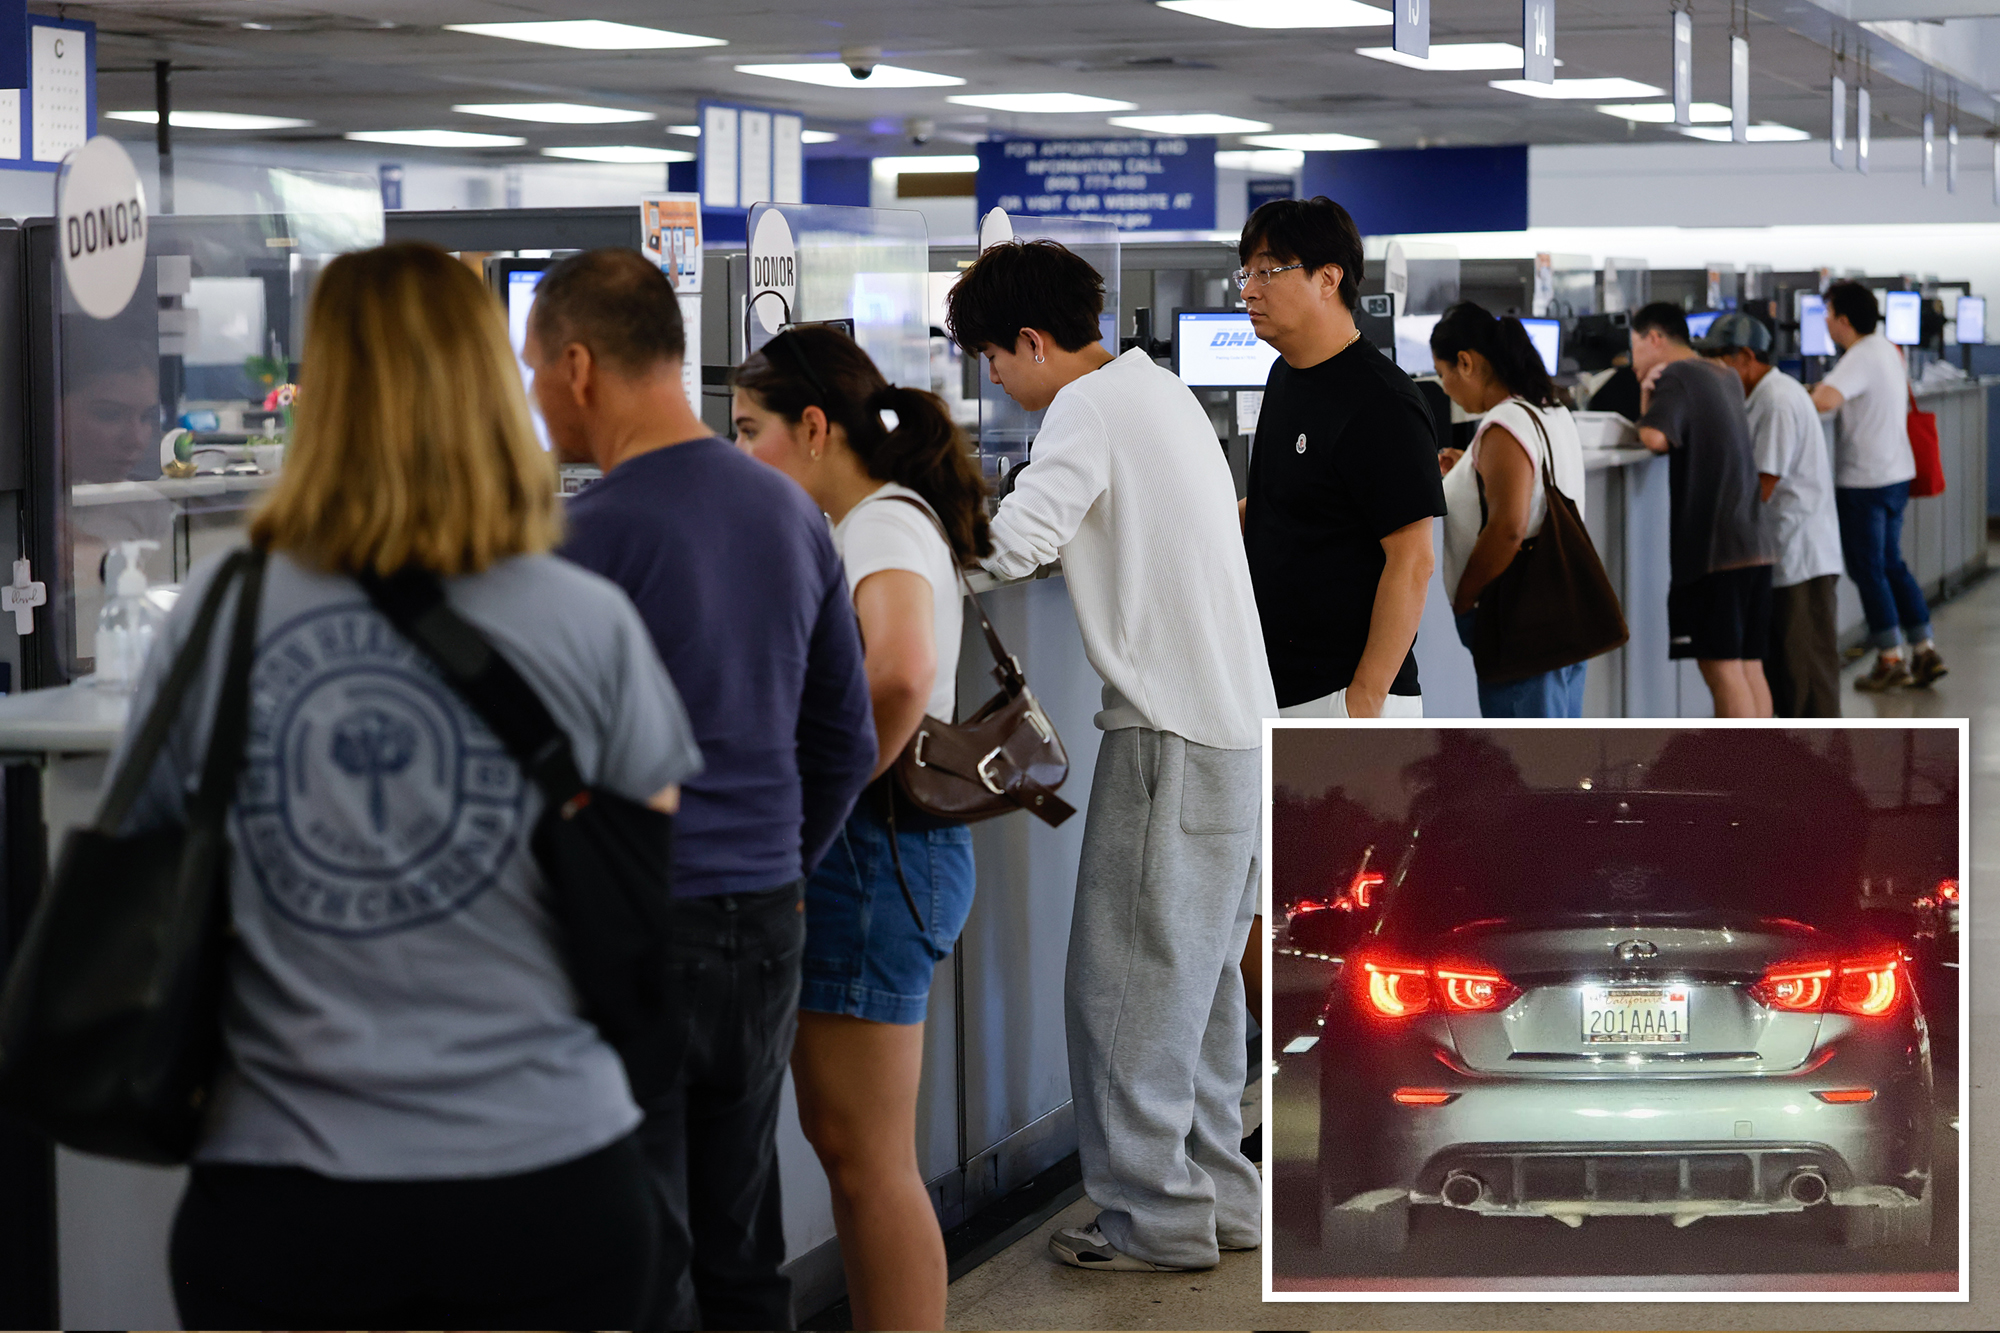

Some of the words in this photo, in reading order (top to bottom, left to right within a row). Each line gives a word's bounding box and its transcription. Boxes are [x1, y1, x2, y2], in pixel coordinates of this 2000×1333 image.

[1533, 3, 1547, 57] 14
[54, 38, 65, 59] C
[1154, 139, 1188, 155] AND
[1026, 159, 1122, 175] INFORMATION
[1125, 158, 1164, 174] CALL
[1103, 194, 1169, 210] WEBSITE
[1172, 193, 1193, 209] AT
[68, 198, 142, 258] DONOR
[754, 256, 794, 287] DONOR
[1210, 332, 1258, 347] DMV
[1591, 1009, 1681, 1034] 201AAA1
